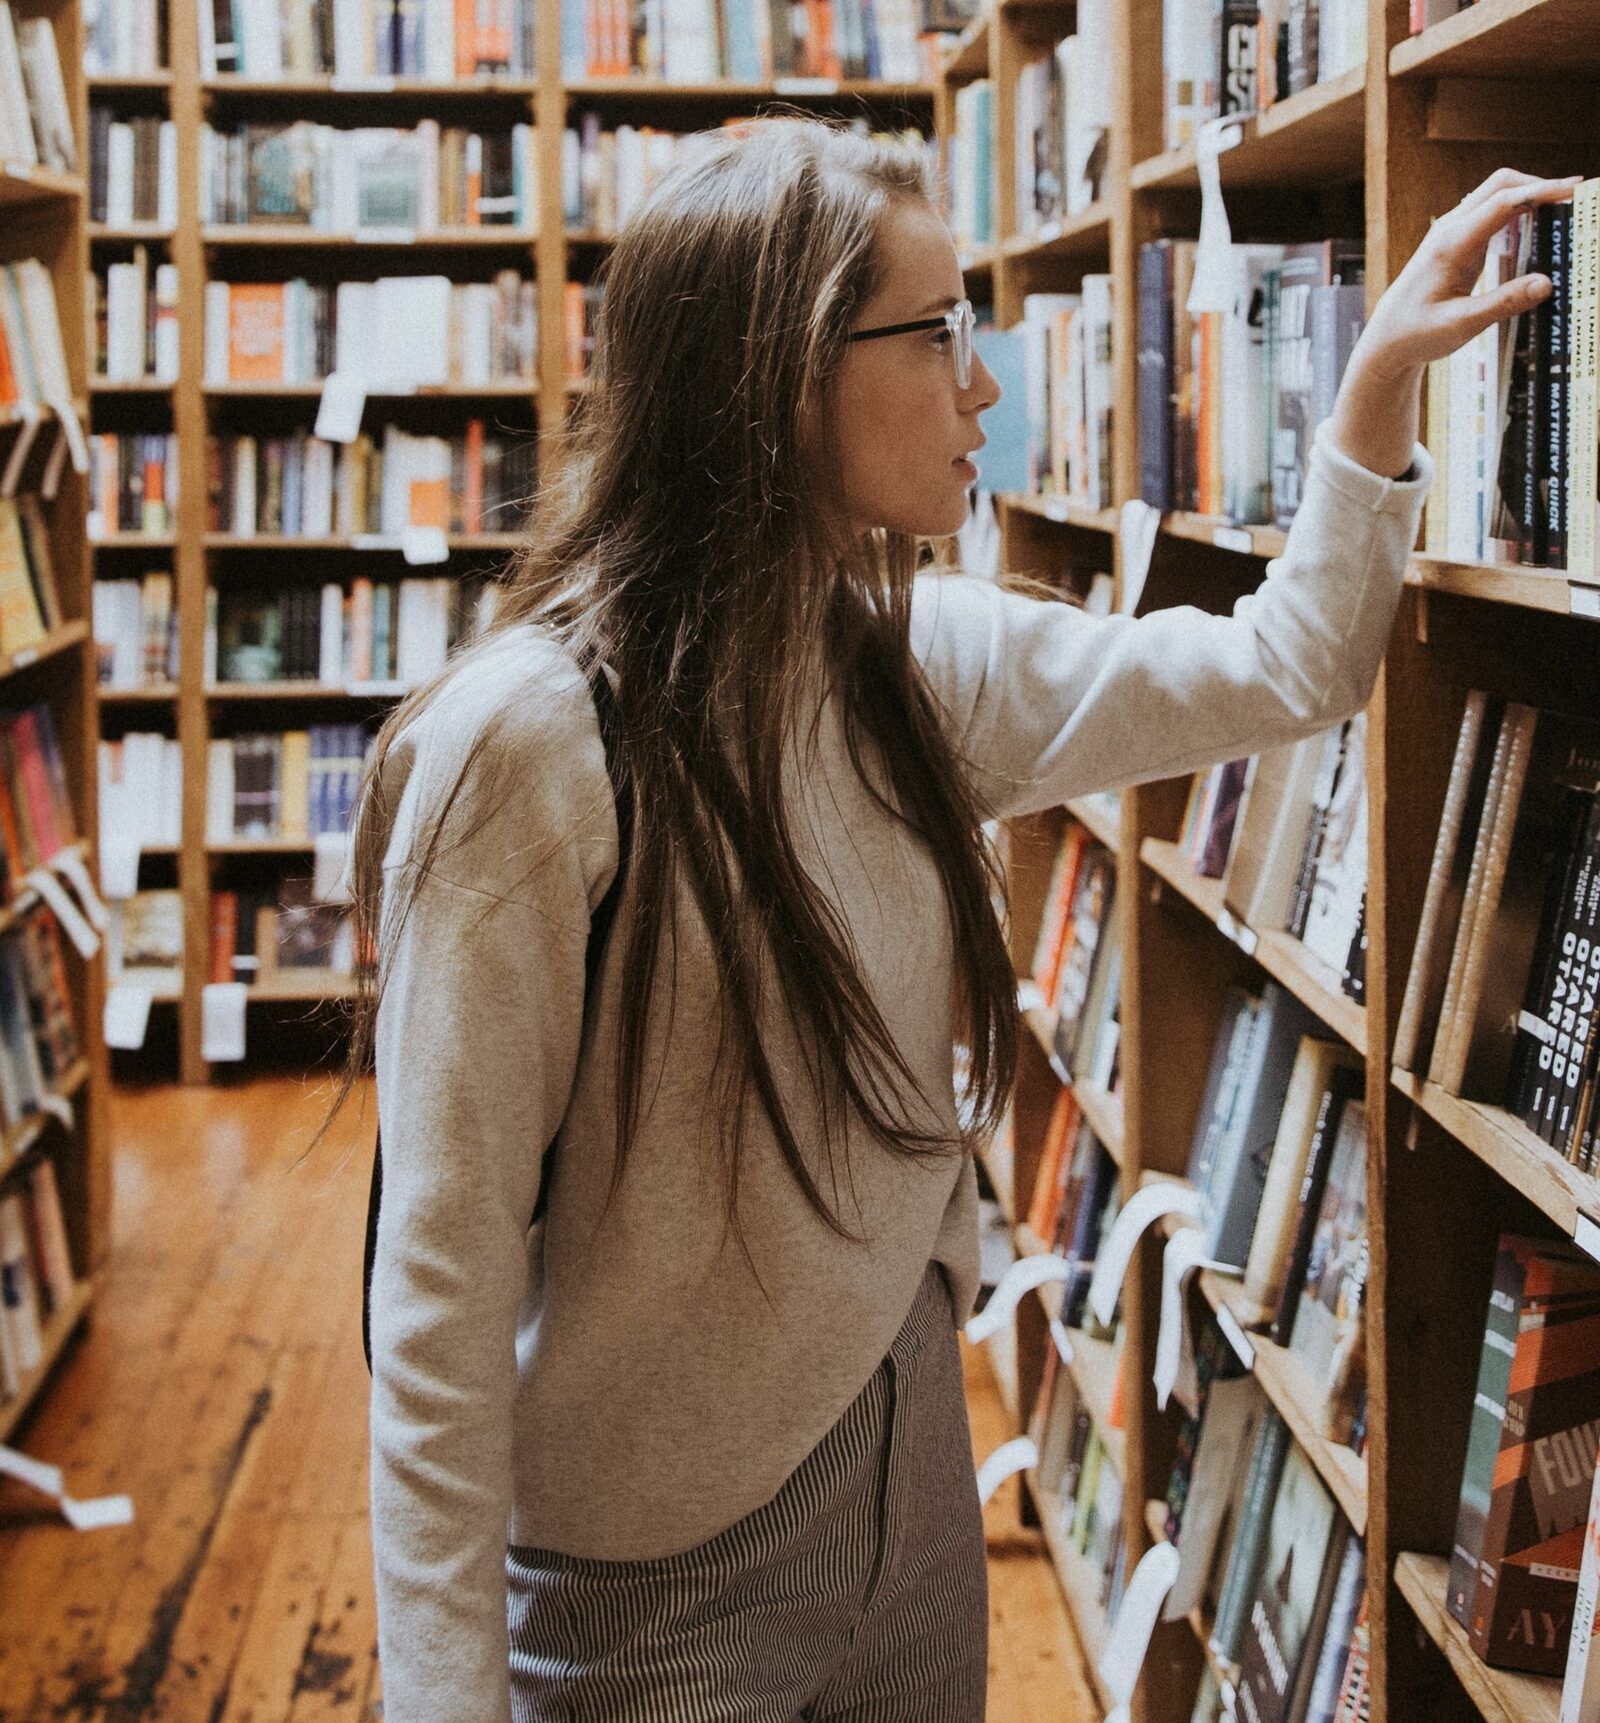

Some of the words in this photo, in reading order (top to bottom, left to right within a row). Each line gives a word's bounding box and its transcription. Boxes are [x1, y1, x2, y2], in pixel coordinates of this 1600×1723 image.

[1552, 220, 1562, 265] LOVE
[1576, 243, 1584, 299] SILVER
[1589, 238, 1597, 297] SILVER
[1551, 316, 1561, 354] FAIL
[1575, 309, 1583, 379] LININGS
[1550, 382, 1560, 473] MATTHEW
[1548, 475, 1559, 532] QUICK
[1538, 931, 1577, 1071] OTARED
[1552, 937, 1590, 1079] OTARED
[1565, 945, 1600, 1088] OTARED
[1535, 1421, 1599, 1495] FOU
